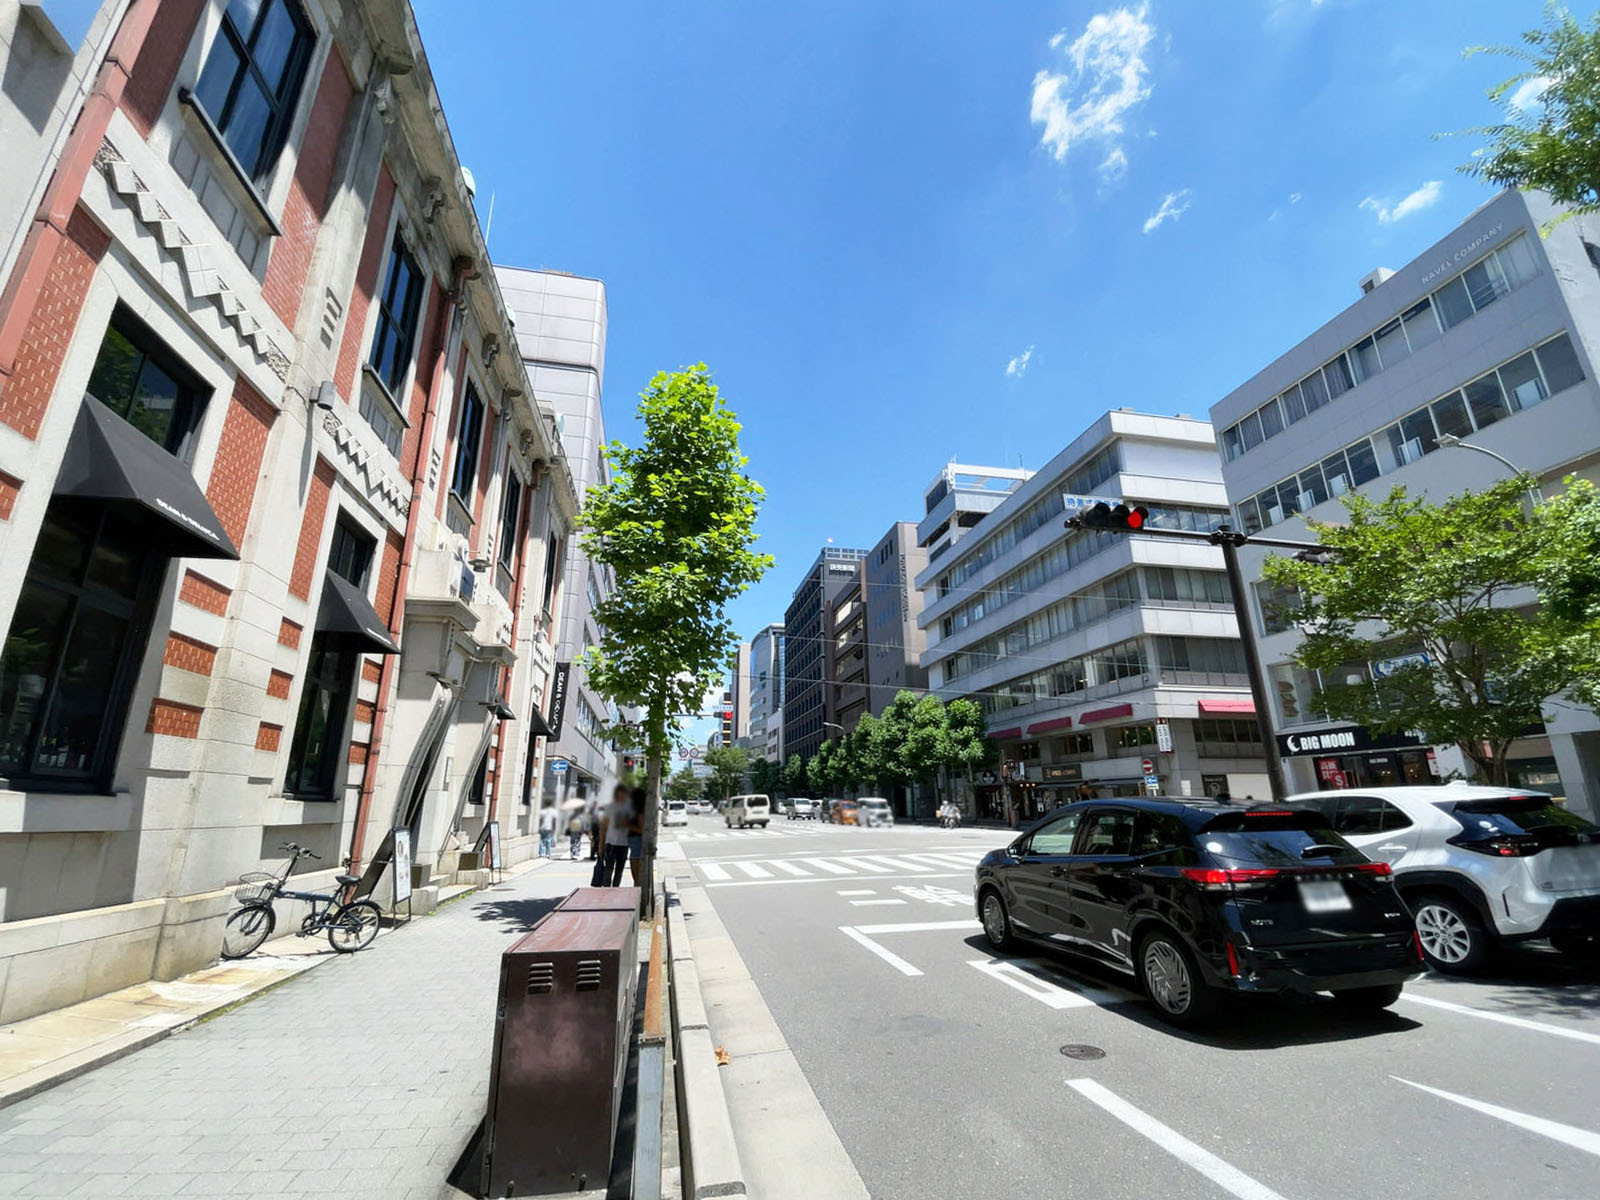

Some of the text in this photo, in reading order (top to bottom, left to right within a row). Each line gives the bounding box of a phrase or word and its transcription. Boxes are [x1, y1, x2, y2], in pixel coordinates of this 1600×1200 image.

[1421, 223, 1504, 284] NAVEL COMPANY
[557, 672, 565, 692] DEAN
[1299, 732, 1356, 751] BIG MOON
